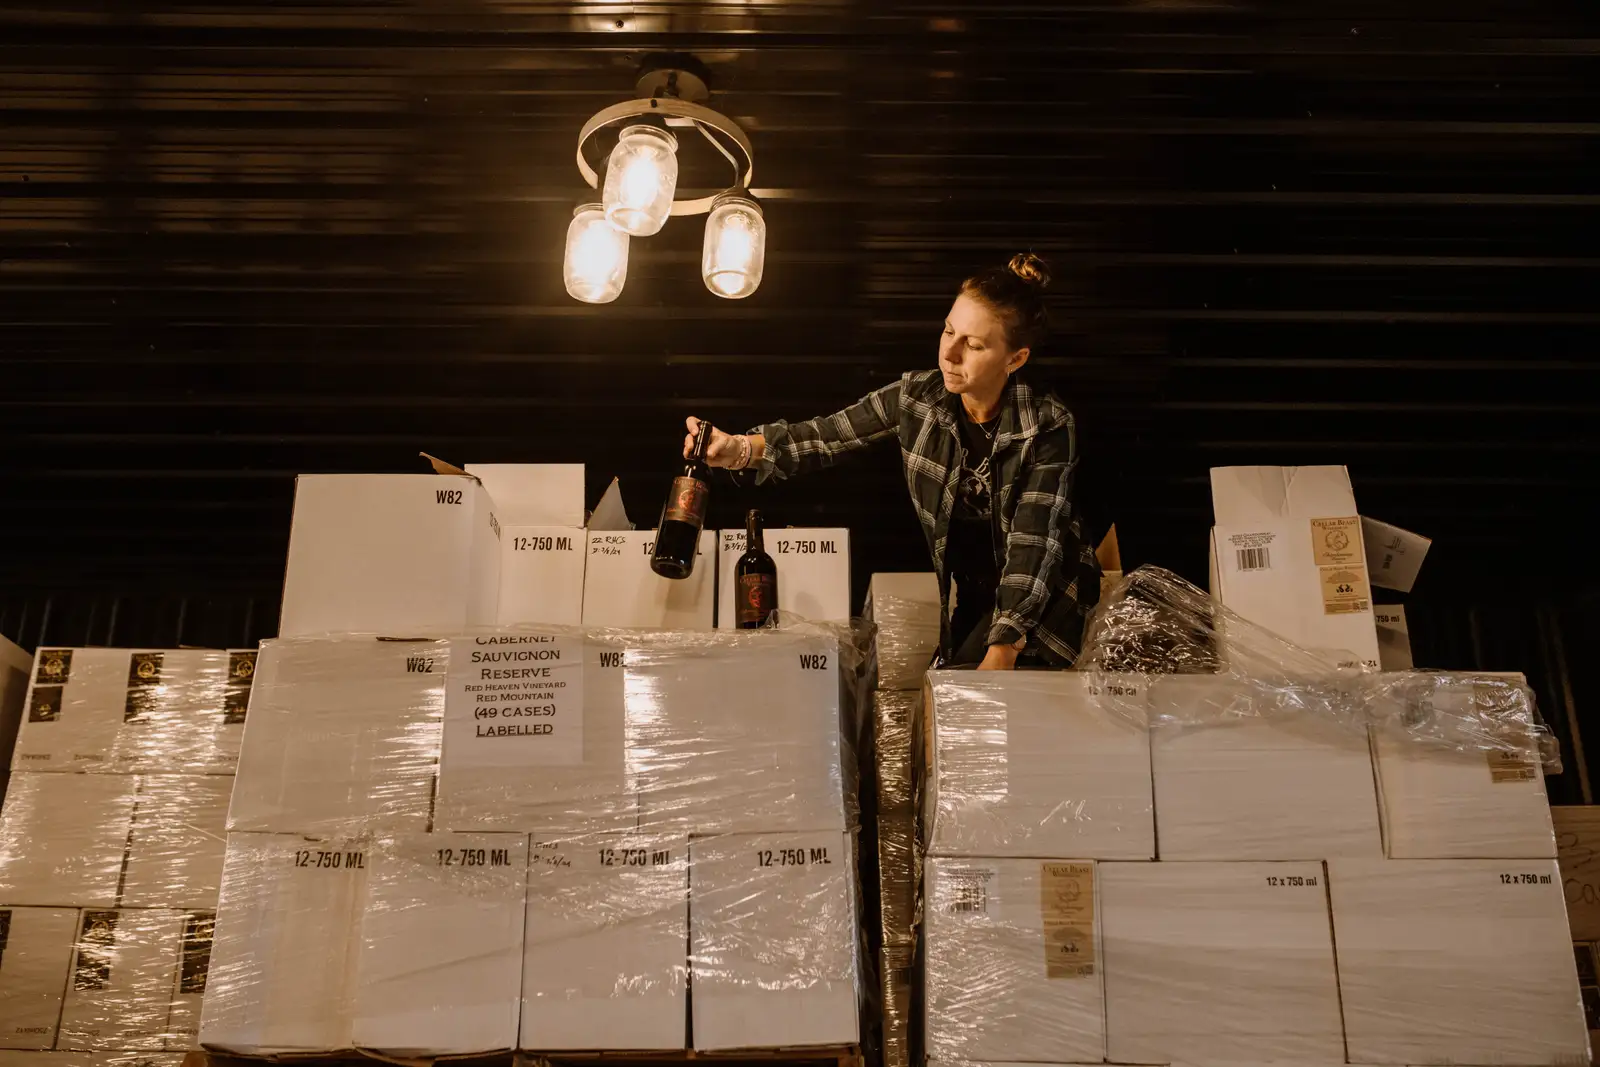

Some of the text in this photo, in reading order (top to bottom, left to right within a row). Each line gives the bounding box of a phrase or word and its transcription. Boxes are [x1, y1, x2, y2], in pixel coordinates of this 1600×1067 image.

[436, 490, 462, 505] W82
[514, 537, 573, 551] 12-750 ML
[777, 540, 837, 554] 12-750 ML
[1376, 615, 1400, 623] 750 ml
[471, 650, 560, 663] SAUVIGNON
[799, 654, 828, 670] W82
[406, 657, 434, 673] W82
[481, 668, 551, 680] RESERVE
[464, 681, 567, 692] RED HEAVEN VINEYARD
[476, 692, 554, 703] RED MOUNTAIN
[474, 703, 556, 720] (49 CASES)
[476, 723, 554, 738] LABELLED
[295, 850, 365, 869] 12-750 ML
[437, 849, 511, 866] 12-750 ML
[599, 850, 647, 866] 12-750
[757, 848, 831, 867] 12-750 ML
[1266, 876, 1318, 886] 12 x 750 ml
[1500, 873, 1552, 884] 12 x 750 ml
